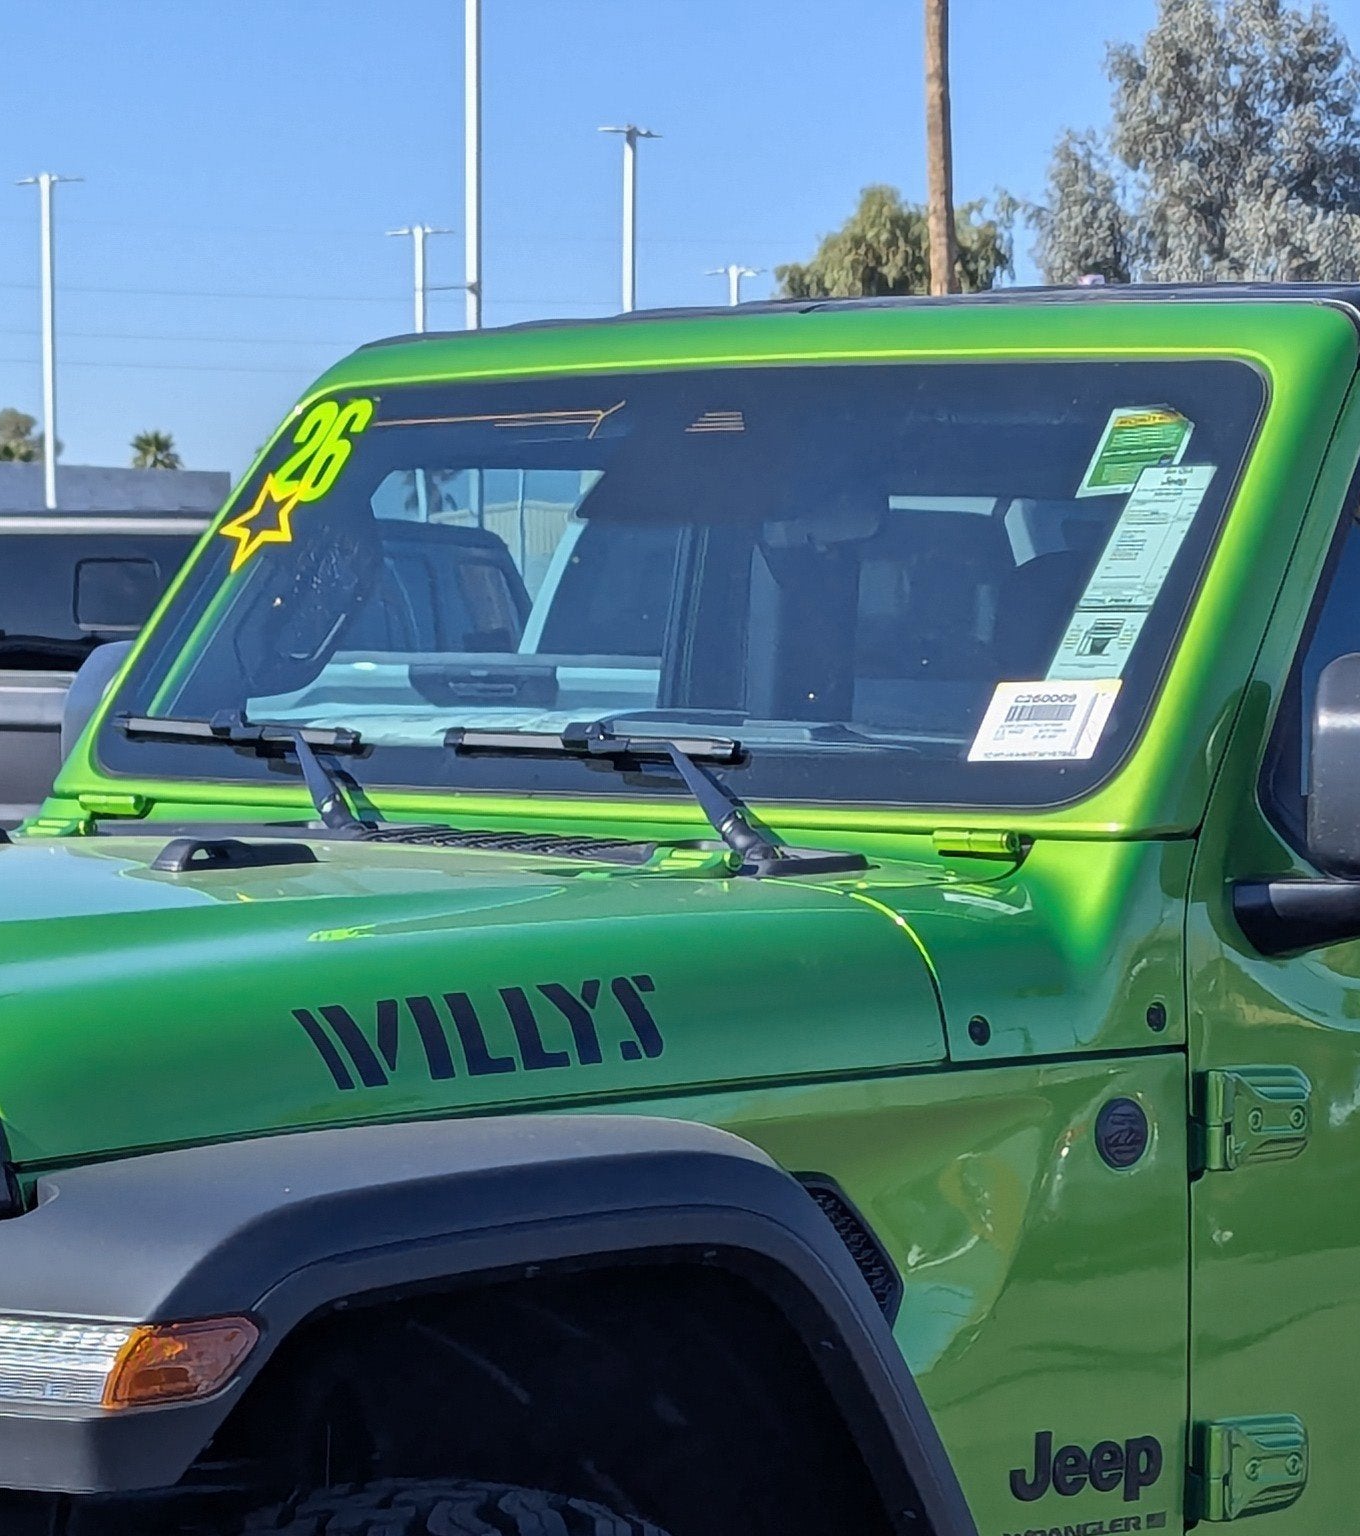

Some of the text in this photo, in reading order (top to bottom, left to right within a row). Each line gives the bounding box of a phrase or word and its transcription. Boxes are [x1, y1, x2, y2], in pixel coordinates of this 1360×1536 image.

[274, 398, 374, 503] 26
[290, 974, 665, 1091] WILLYS
[1008, 1430, 1163, 1502] Jeep
